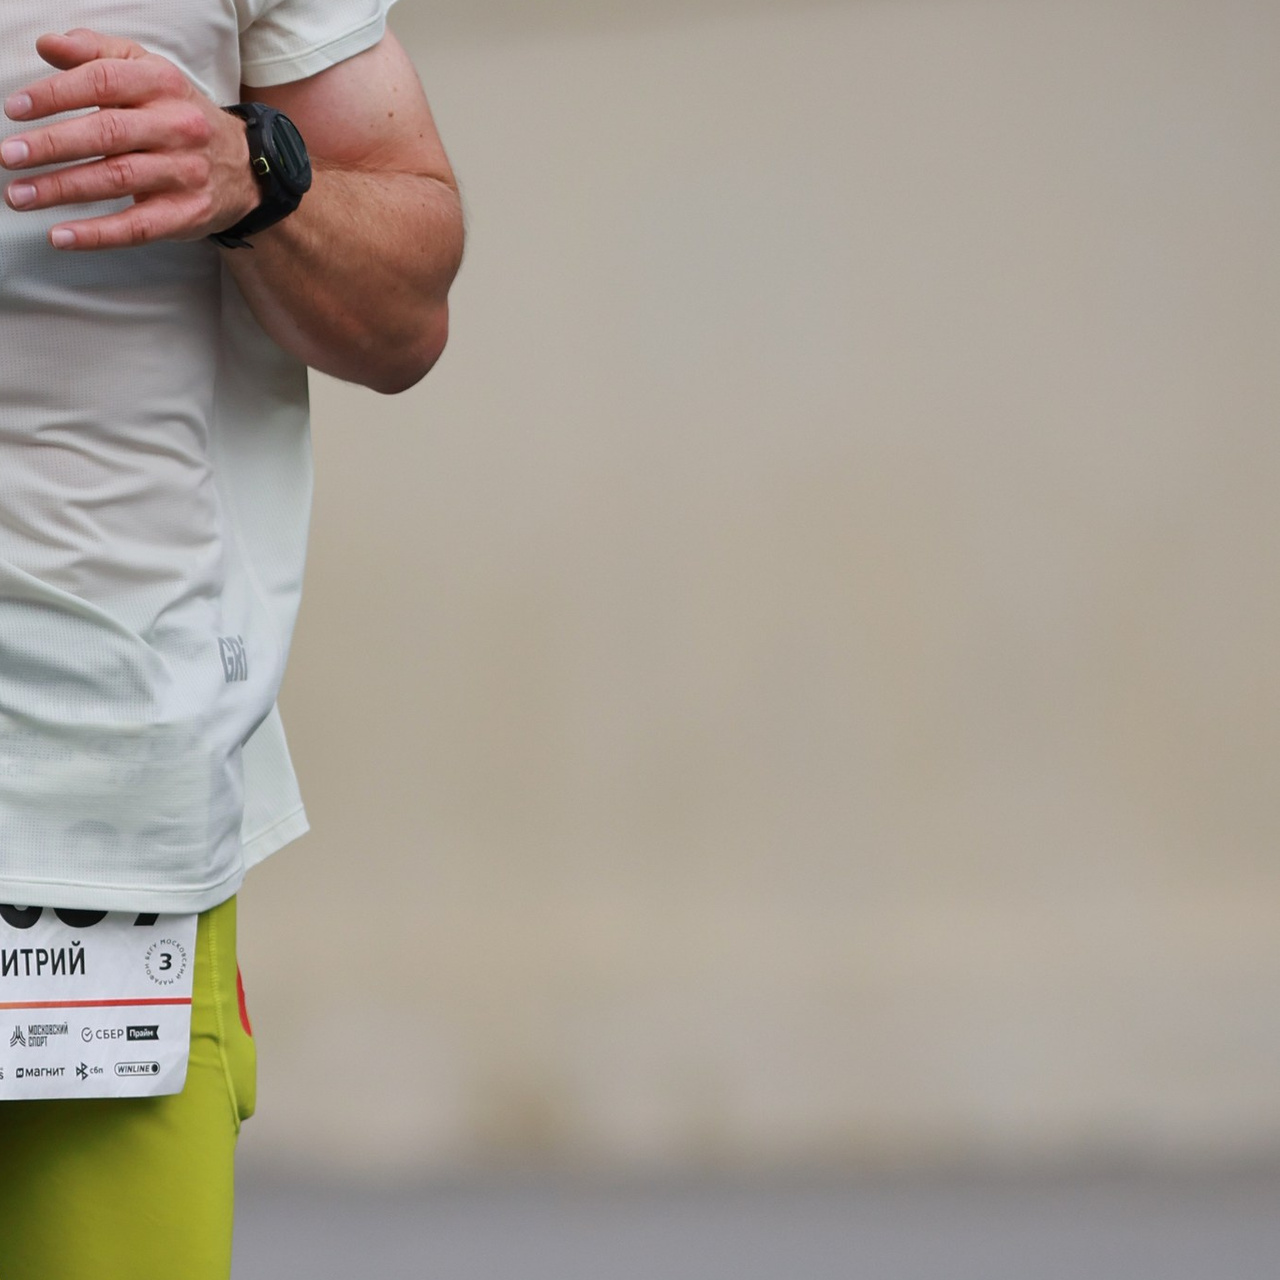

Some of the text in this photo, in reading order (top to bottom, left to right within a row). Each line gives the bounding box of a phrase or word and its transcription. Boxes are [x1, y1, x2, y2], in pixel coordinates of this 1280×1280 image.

[158, 952, 173, 971] 3
[28, 1021, 69, 1035] МОСКОВСКИЙ
[95, 1028, 154, 1040] СБЕР Прайм
[28, 1036, 48, 1047] СПОРТ
[117, 1065, 150, 1073] WINLINE
